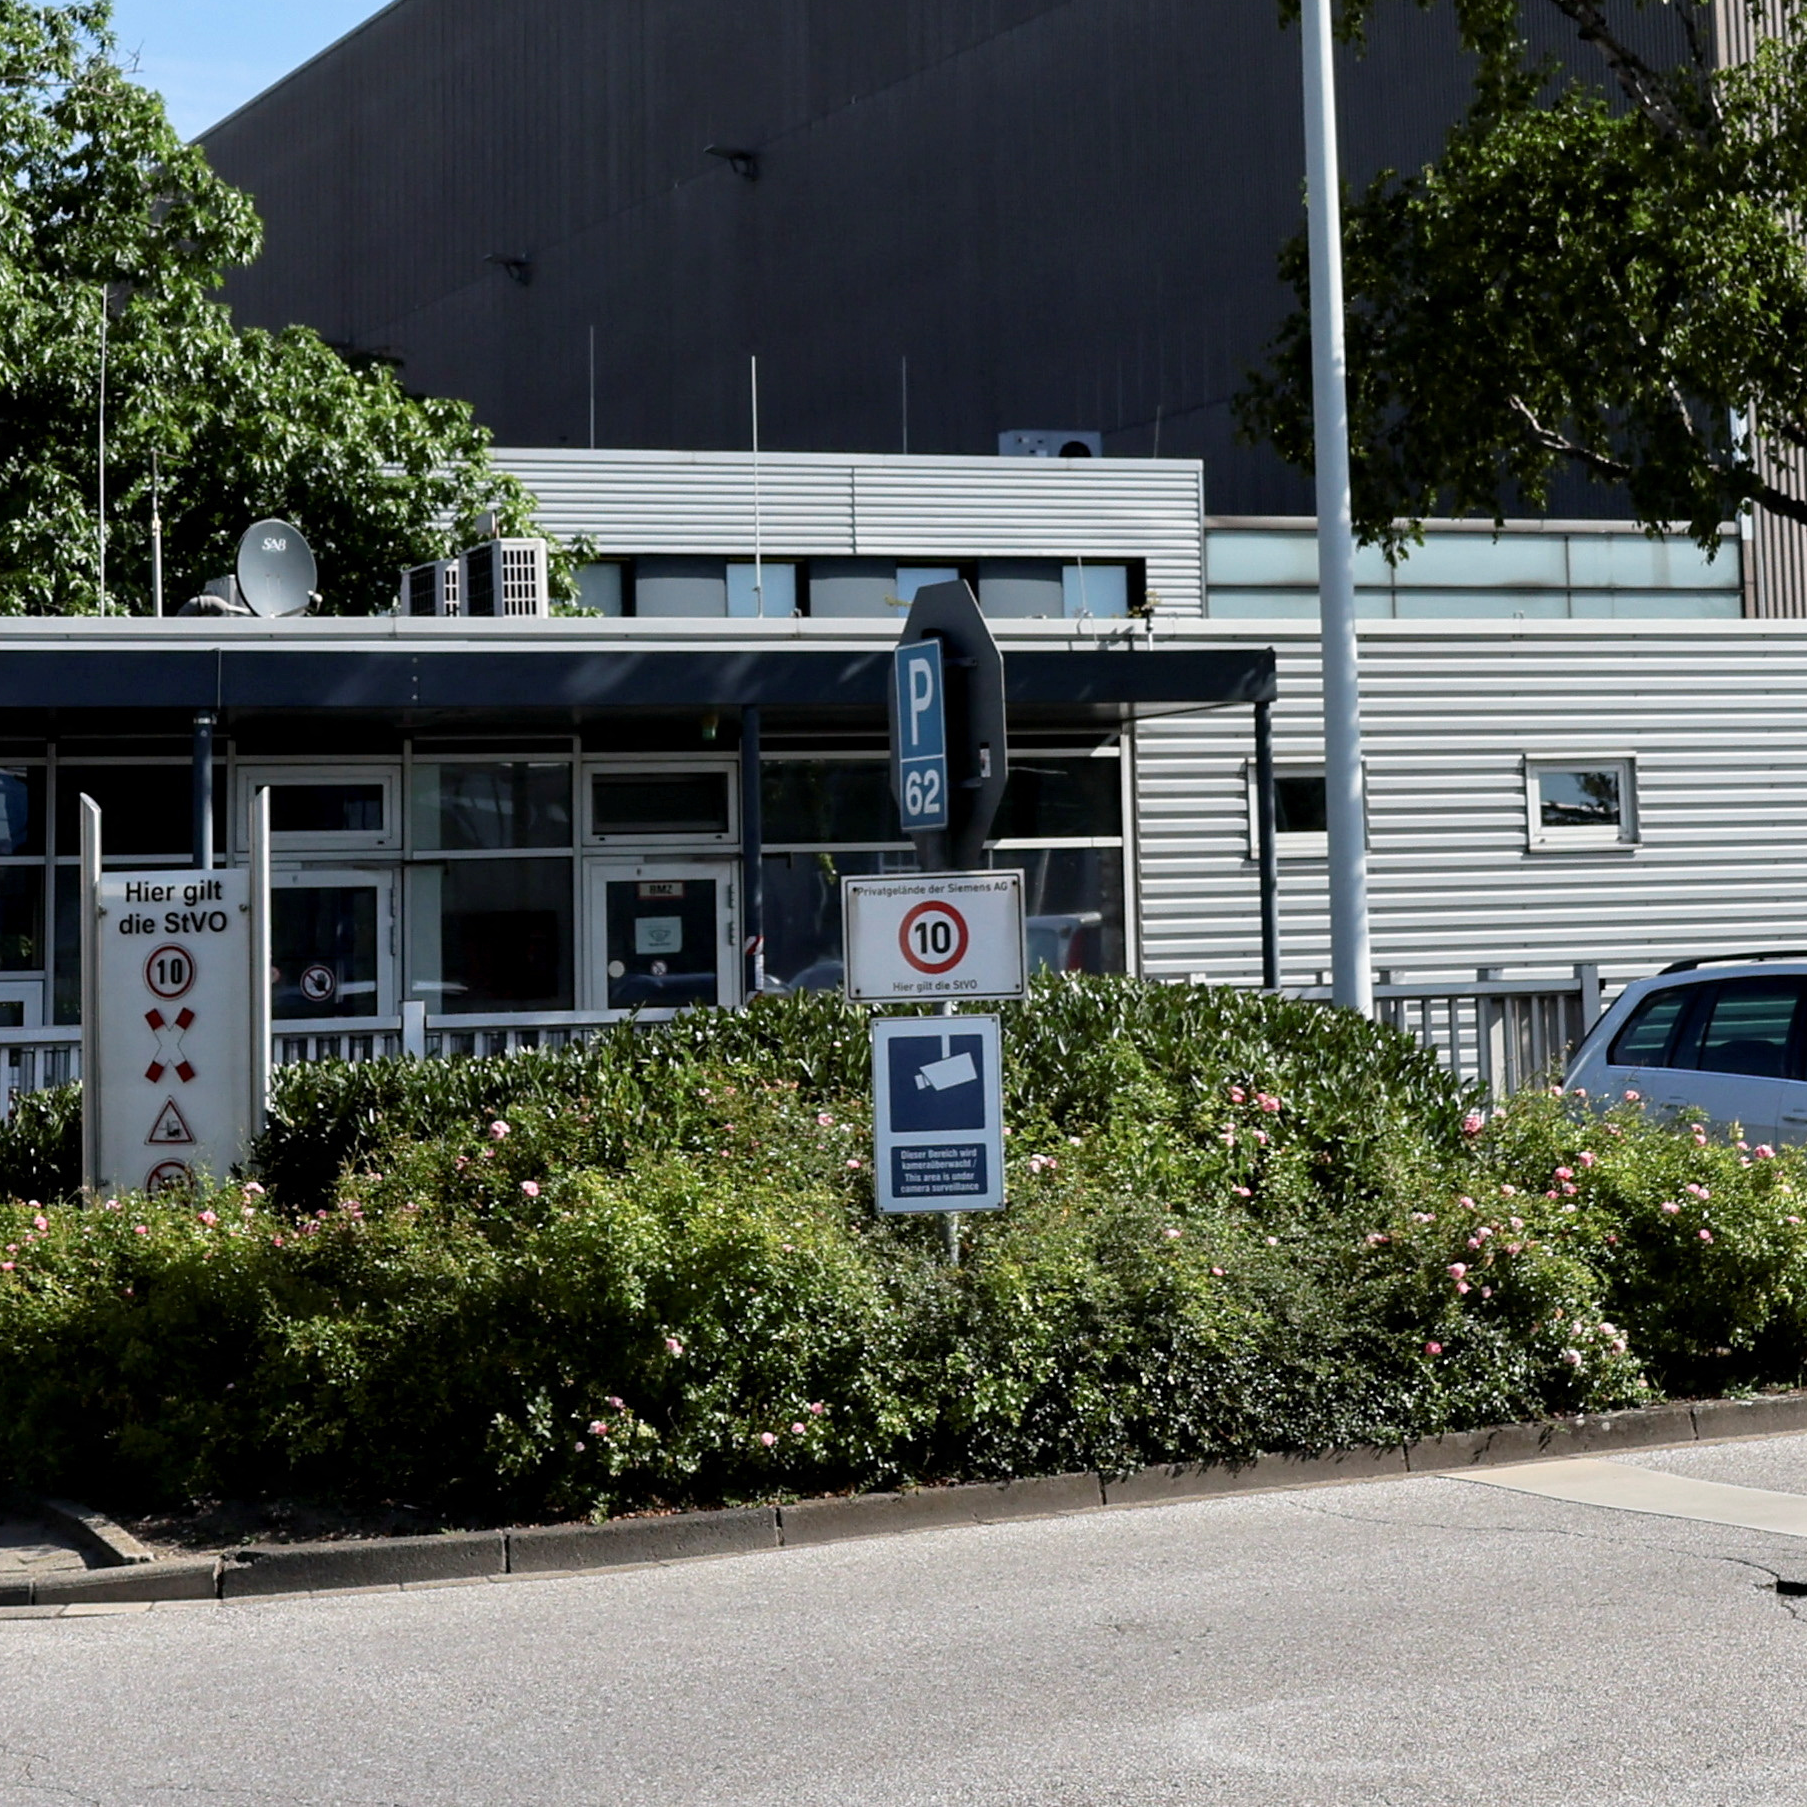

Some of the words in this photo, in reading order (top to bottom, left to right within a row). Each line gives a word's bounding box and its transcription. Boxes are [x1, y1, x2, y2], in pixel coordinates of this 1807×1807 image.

[909, 658, 933, 746] P
[906, 769, 940, 816] 62
[125, 880, 175, 902] Hier
[183, 879, 222, 907] gilt
[858, 883, 926, 898] Privatgelände
[929, 883, 945, 894] der
[948, 881, 991, 894] Siemens
[993, 881, 1008, 892] AG
[119, 913, 155, 935] die
[164, 911, 227, 934] StVO
[915, 921, 951, 955] 10
[157, 958, 183, 985] 10
[893, 981, 913, 992] Hier
[917, 980, 933, 993] gilt
[935, 980, 950, 991] die
[953, 979, 978, 990] StVO
[928, 1148, 958, 1159] Bereich
[900, 1183, 930, 1194] camera
[923, 1174, 941, 1182] area
